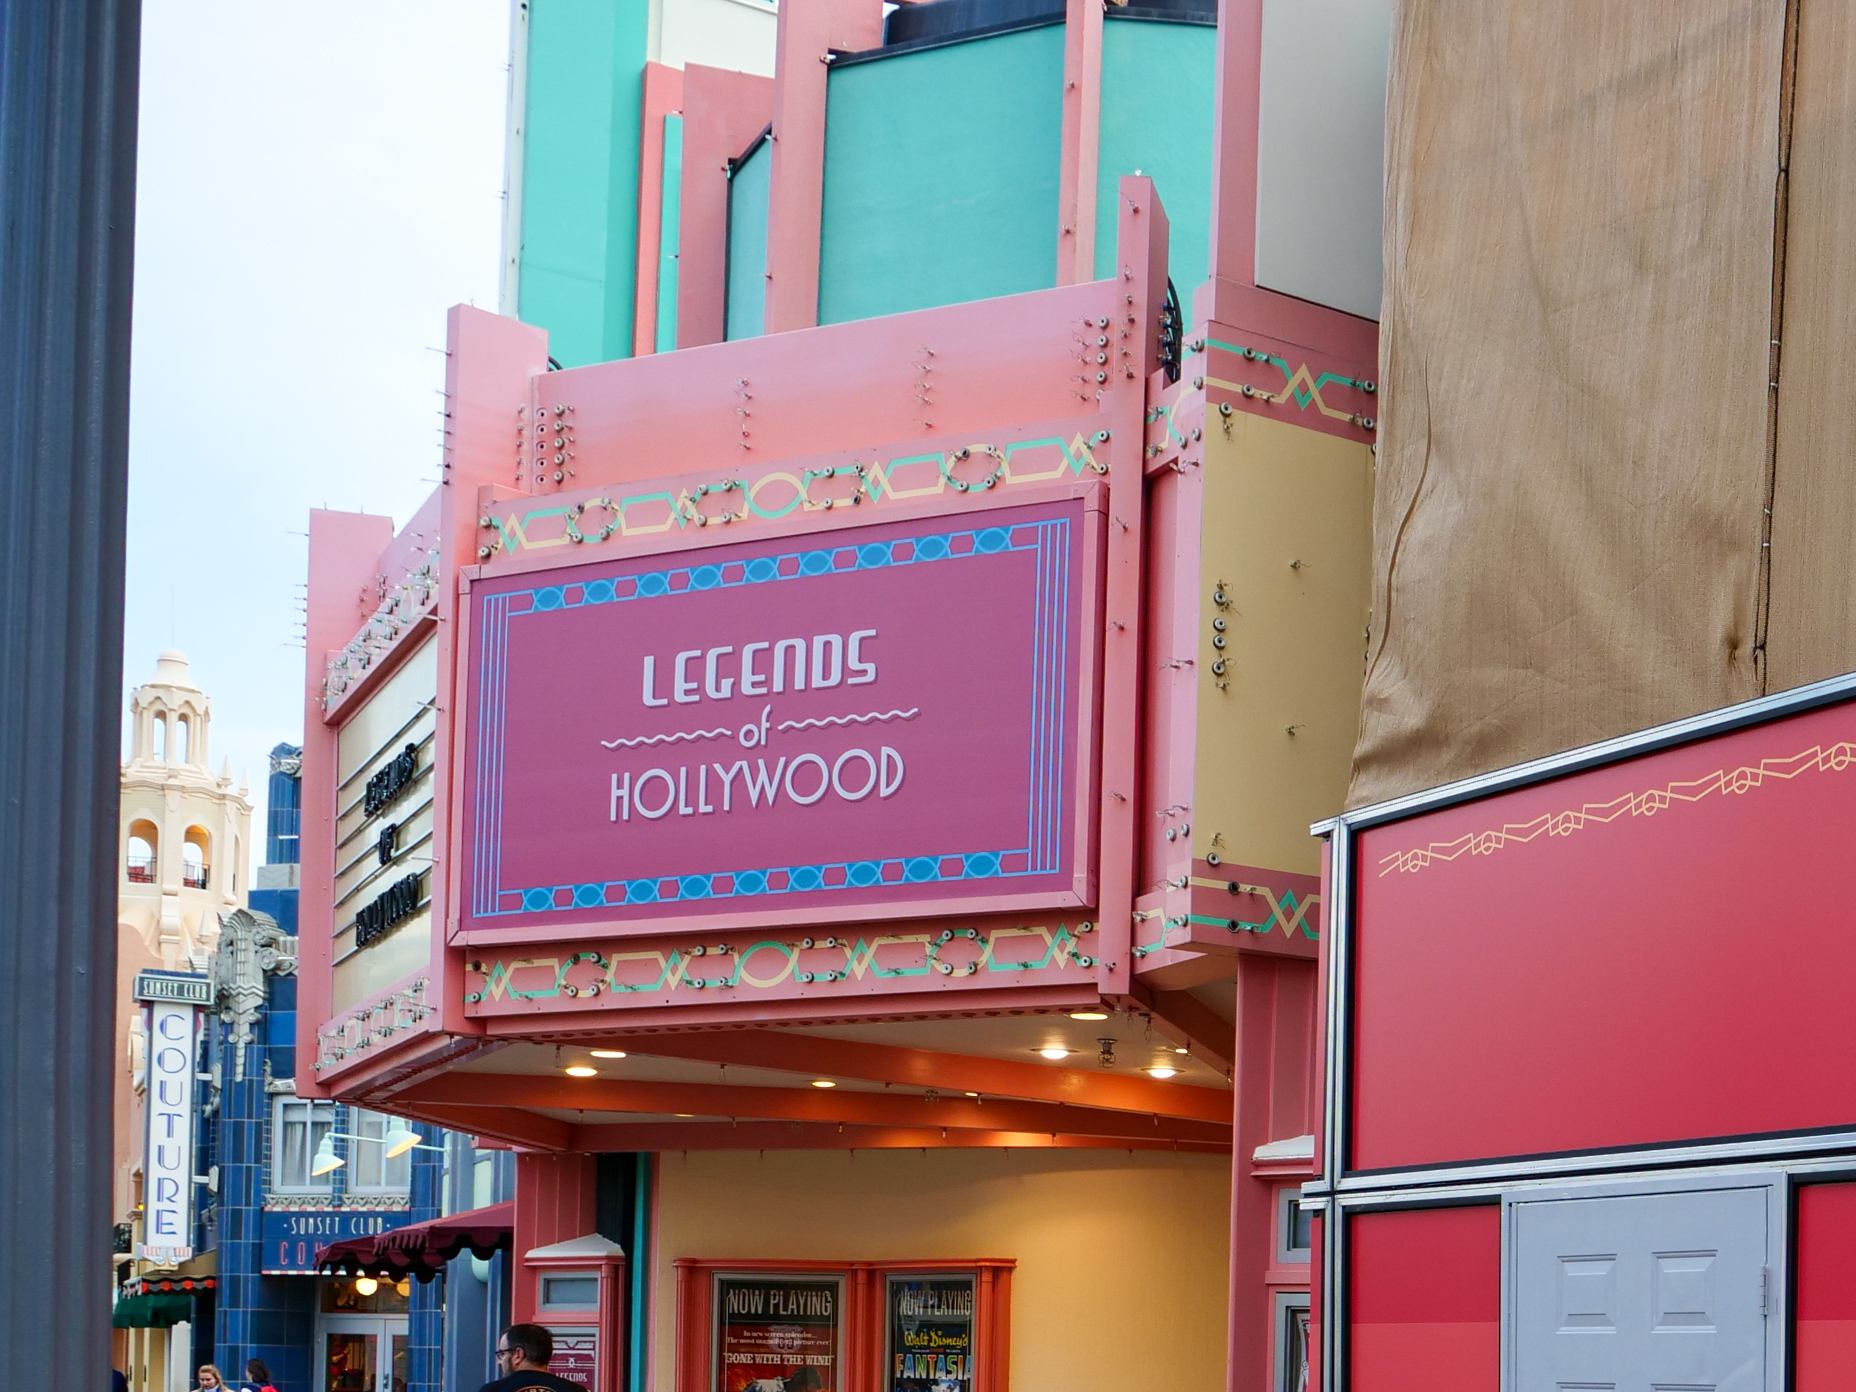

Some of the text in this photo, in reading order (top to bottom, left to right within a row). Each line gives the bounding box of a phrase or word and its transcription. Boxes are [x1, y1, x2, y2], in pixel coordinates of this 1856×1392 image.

[642, 629, 877, 707] LEGENDS
[739, 704, 771, 748] of
[610, 746, 905, 821] HOLLYWOOD
[143, 980, 207, 1000] SUNSET CLUB
[155, 1014, 187, 1235] COUTURE
[291, 1217, 383, 1234] SUNSET CLUB
[729, 1288, 832, 1316] NOW PLAYING
[900, 1289, 971, 1316] NOW PLAYING
[904, 1330, 968, 1348] Walt Disney's
[755, 1354, 781, 1364] WITH
[782, 1354, 804, 1366] THE
[896, 1354, 972, 1380] FANTASIA
